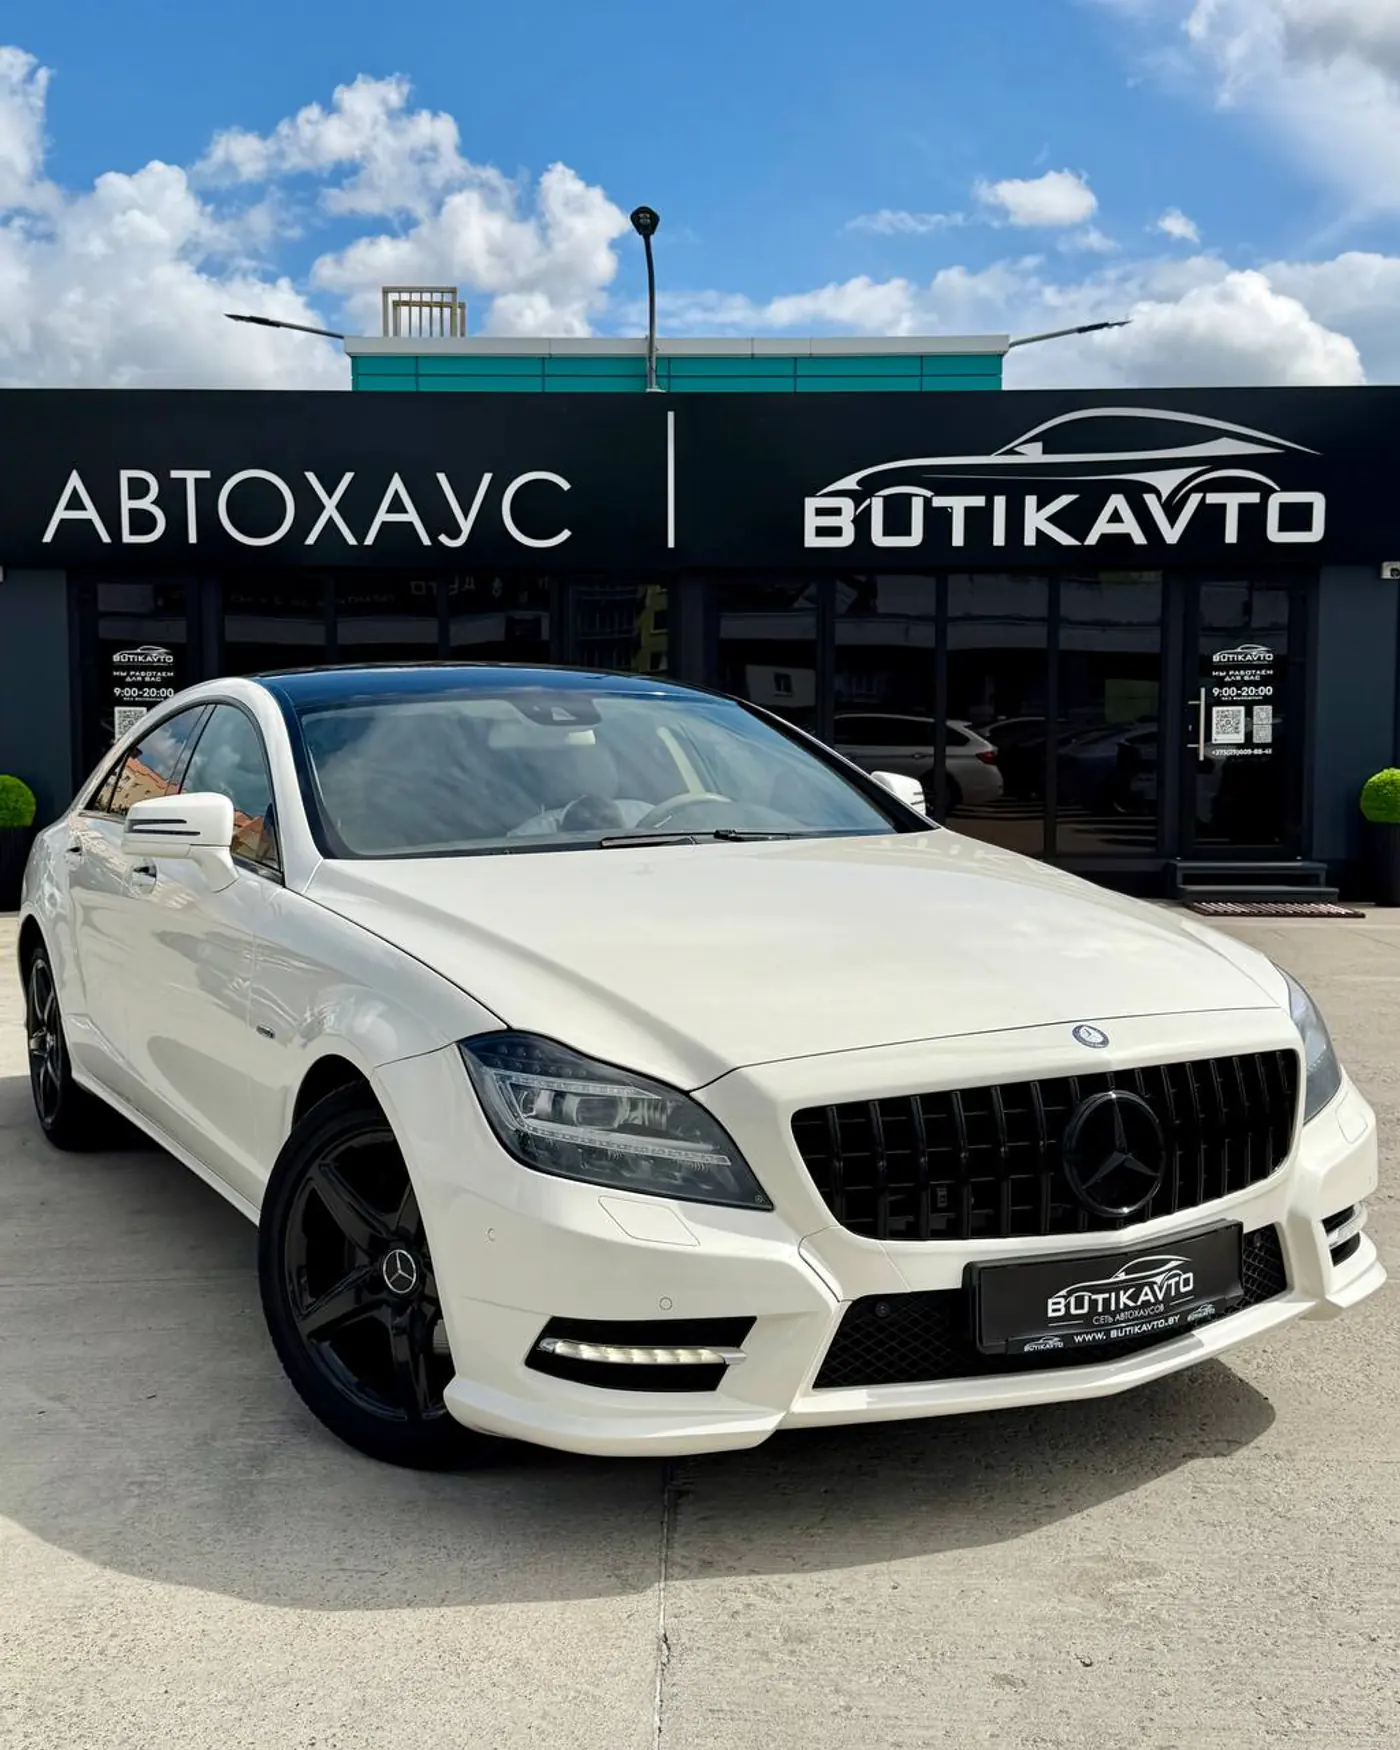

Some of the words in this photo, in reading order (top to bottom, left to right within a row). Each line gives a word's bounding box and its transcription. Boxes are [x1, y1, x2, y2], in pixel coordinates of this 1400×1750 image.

[42, 468, 573, 549] АВТОХАУС
[803, 490, 1326, 548] BUTIKAVTO
[113, 688, 174, 697] 9:00-20:00
[1212, 686, 1273, 697] 9:00-20:00
[1047, 1273, 1194, 1317] BUTIKAVTO
[1092, 1315, 1113, 1325] СЕТЬ
[1114, 1303, 1165, 1321] АВТОХАУСОВ
